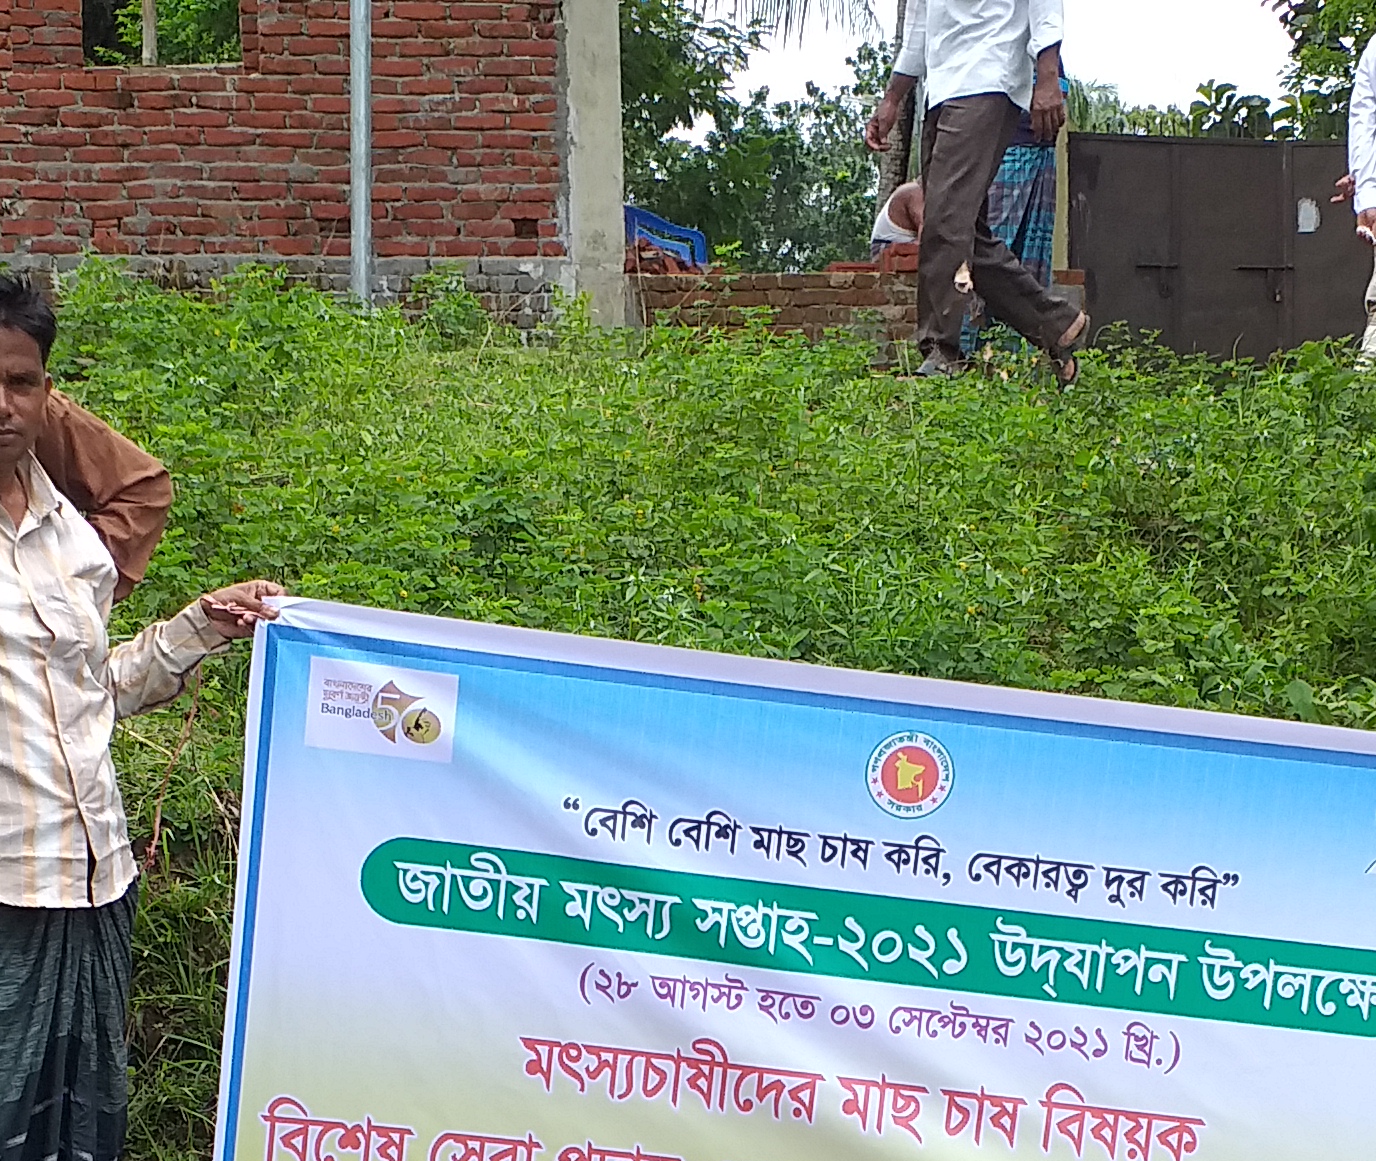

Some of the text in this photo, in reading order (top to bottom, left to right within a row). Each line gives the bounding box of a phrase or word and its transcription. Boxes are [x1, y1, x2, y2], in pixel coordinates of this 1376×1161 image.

[321, 702, 392, 721] Bangladesh
[669, 811, 742, 854] বেশি
[750, 825, 810, 866] মাছ
[818, 834, 874, 869] চাষ
[883, 835, 950, 885] করি,
[969, 854, 1094, 902] বেকারত্ব
[1103, 867, 1151, 907] দুর
[395, 853, 548, 922] জাতীয়
[560, 882, 681, 939] মৎস্য
[693, 899, 967, 978] সপ্তাহ-২০২১
[580, 962, 638, 1004] (২৮
[652, 978, 747, 1010] আগস্ট
[758, 990, 819, 1019] হতে
[831, 1006, 874, 1029] ০৩
[890, 1006, 1012, 1044] সেপ্টেম্বর
[1026, 1023, 1107, 1057] ২০২১
[521, 1039, 824, 1122] মৎস্যচাষীদের
[838, 1078, 927, 1142] মাছ
[942, 1090, 1025, 1146] চাষ
